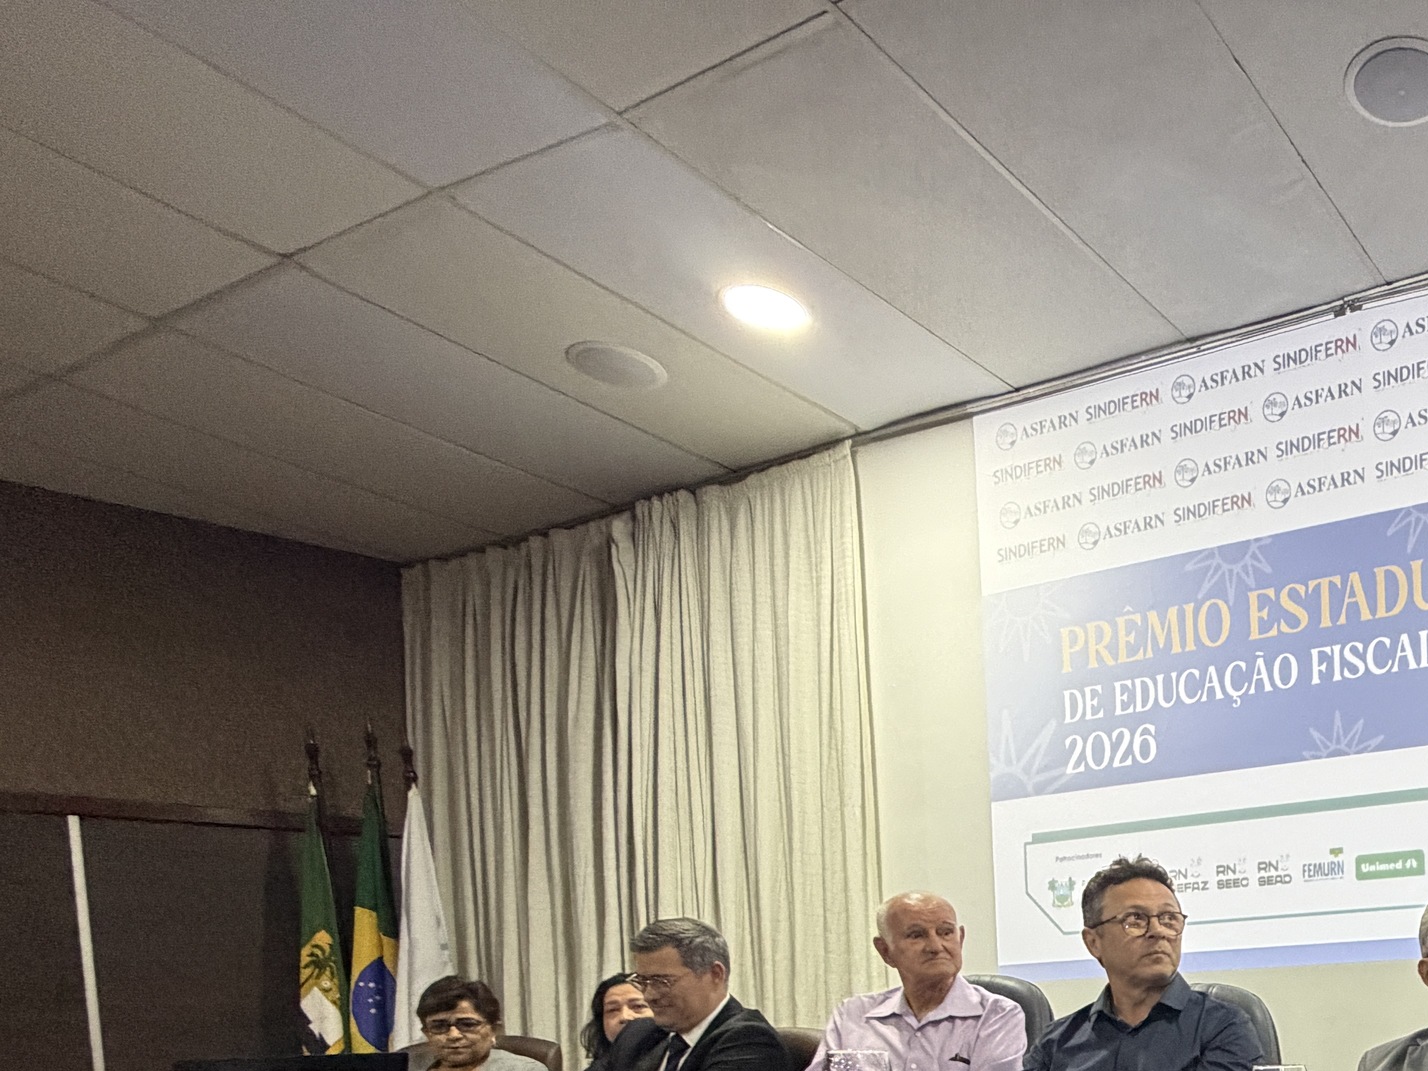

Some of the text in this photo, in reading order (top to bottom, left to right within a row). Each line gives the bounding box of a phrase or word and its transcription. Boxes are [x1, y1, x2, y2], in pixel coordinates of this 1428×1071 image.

[1020, 411, 1079, 440] ASFARN
[1085, 388, 1160, 422] SINDIFERN
[1198, 359, 1266, 393] ASFARN
[1273, 333, 1357, 371] SINDIFERN
[993, 453, 1062, 485] SINDIFERN
[1099, 428, 1162, 459] ASFARN
[1170, 406, 1249, 441] SINDIFERN
[1290, 378, 1363, 410] ASFARN
[1023, 491, 1082, 520] ASFARN
[1088, 470, 1163, 503] SINDIFERN
[1201, 446, 1268, 477] ASFARN
[1275, 423, 1360, 459] SINDIFERN
[997, 533, 1066, 563] SINDIFERN
[1102, 512, 1166, 542] ASFARN
[1173, 491, 1252, 525] SINDIFERN
[1293, 467, 1366, 499] ASFARN
[1060, 596, 1231, 673] PRÊMIO
[1063, 684, 1103, 723] DE
[1114, 651, 1298, 717] EDUCAÇÃO
[1064, 724, 1157, 774] 2026
[1177, 881, 1209, 893] EFAZ
[1216, 863, 1236, 877] RN
[1257, 860, 1279, 874] RN
[1258, 874, 1292, 887] SEAD
[1302, 859, 1345, 879] FEMURN
[1361, 859, 1402, 873] Unimed
